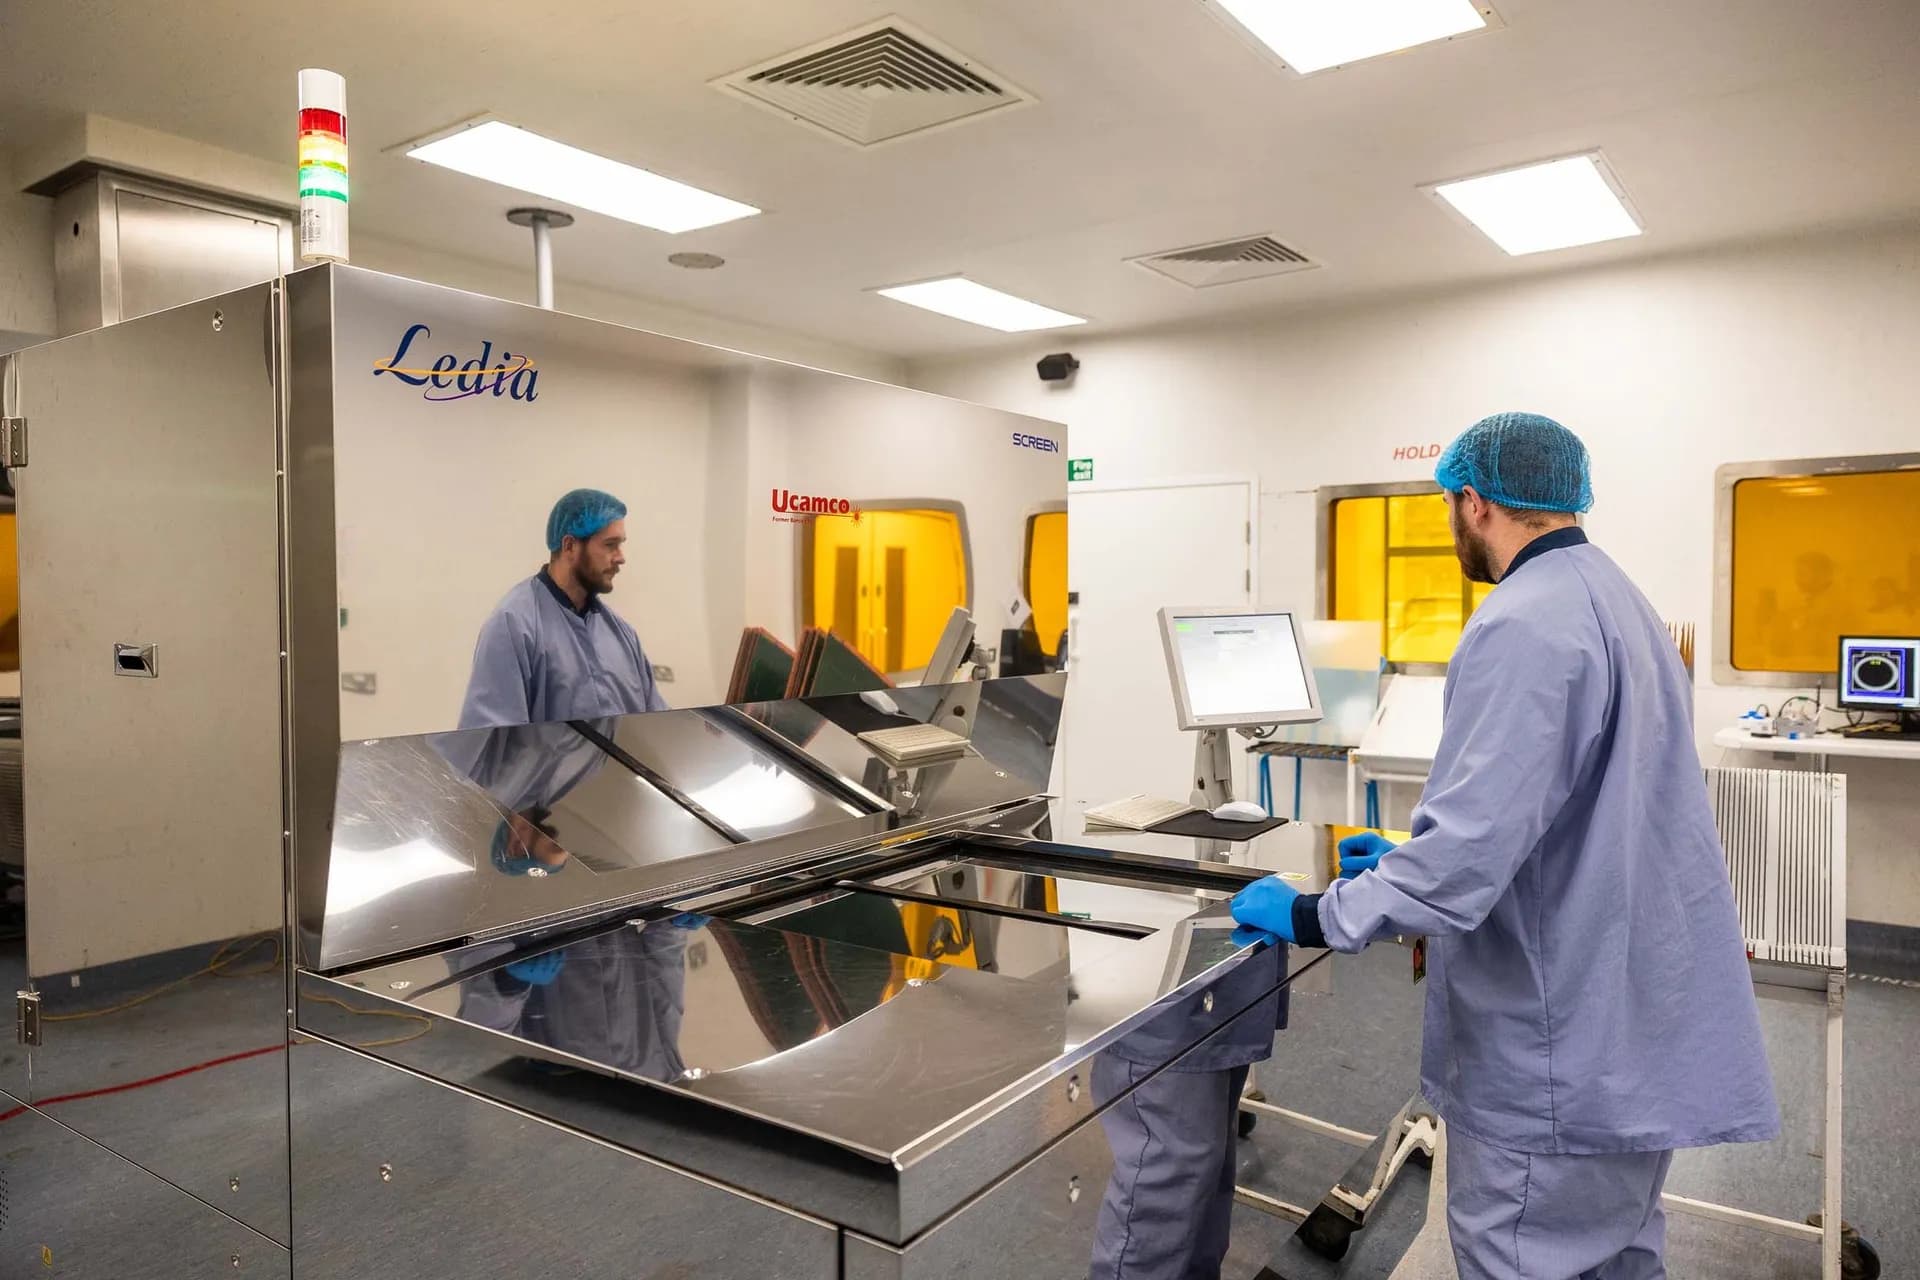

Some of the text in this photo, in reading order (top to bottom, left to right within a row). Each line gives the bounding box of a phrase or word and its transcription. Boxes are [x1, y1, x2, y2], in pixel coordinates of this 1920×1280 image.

[373, 324, 539, 402] Ledia
[1012, 432, 1059, 453] SCREEN
[1393, 444, 1441, 461] HOLD
[772, 488, 850, 514] Ucamco
